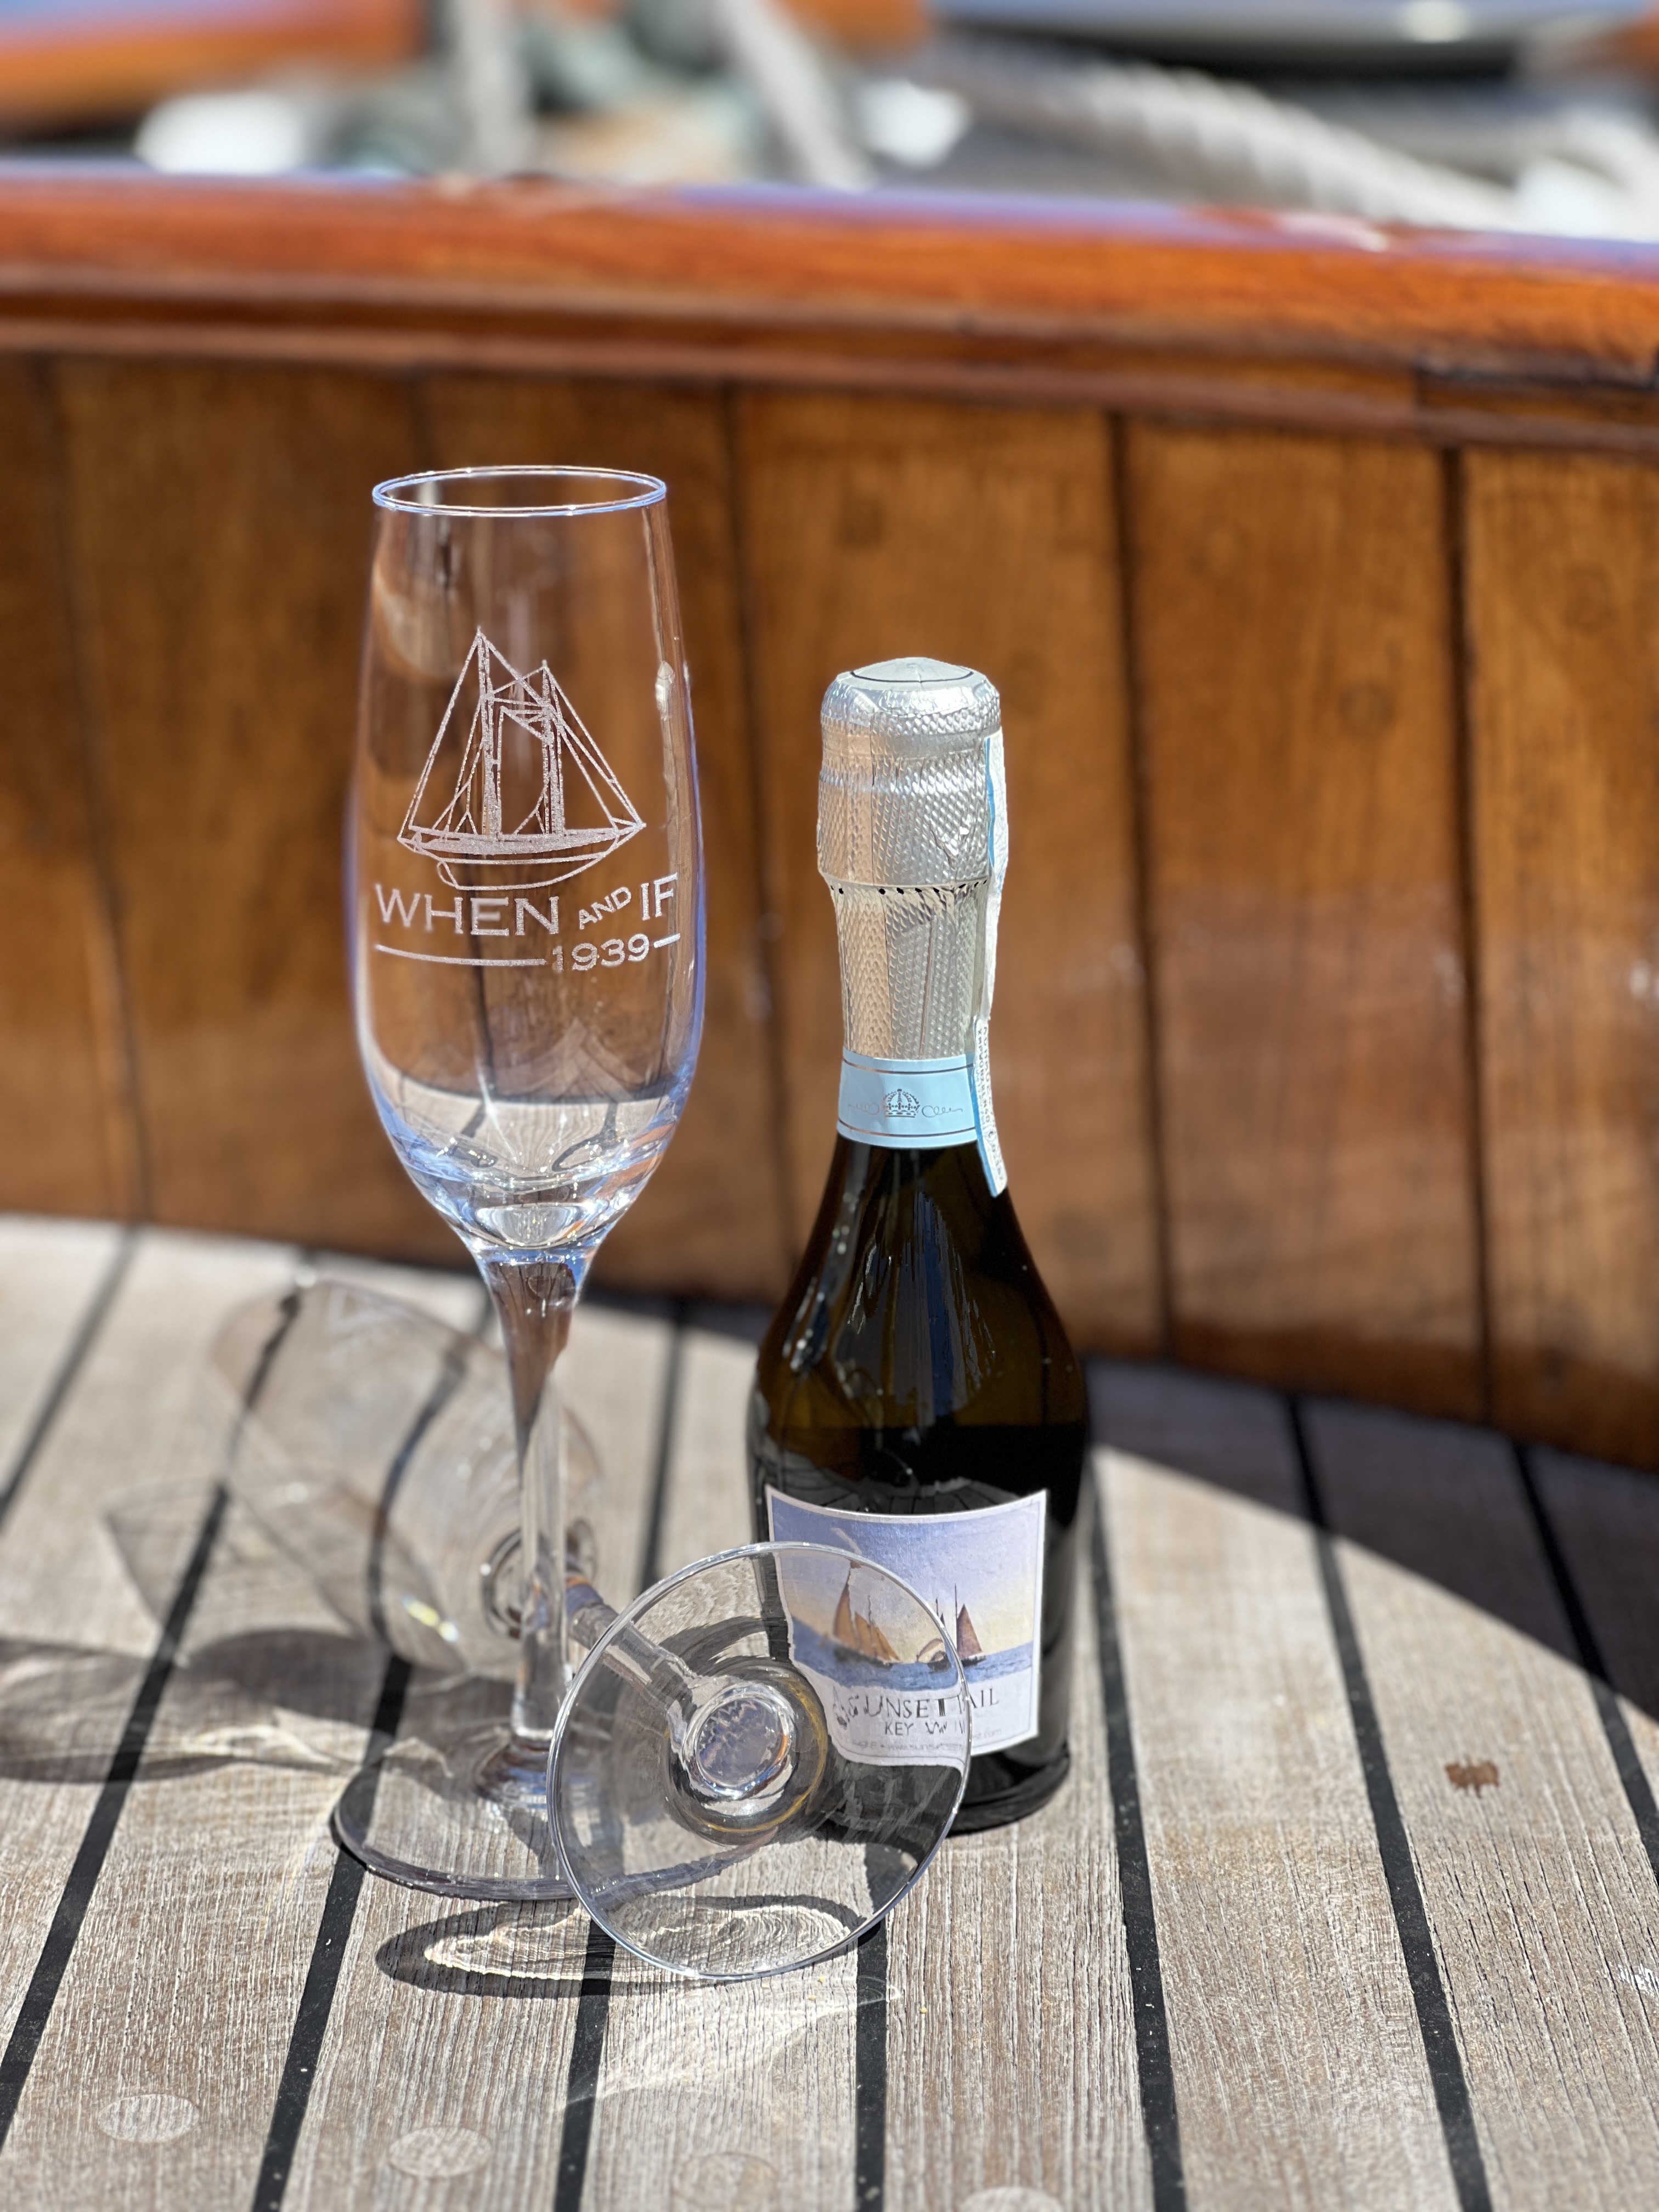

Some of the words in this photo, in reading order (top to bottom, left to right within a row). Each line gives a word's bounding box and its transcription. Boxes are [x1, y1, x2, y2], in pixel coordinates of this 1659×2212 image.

[375, 883, 560, 936] WHEN
[578, 887, 632, 930] AND
[640, 872, 679, 921] IF
[552, 934, 650, 972] 1939
[884, 1721, 915, 1736] KEY
